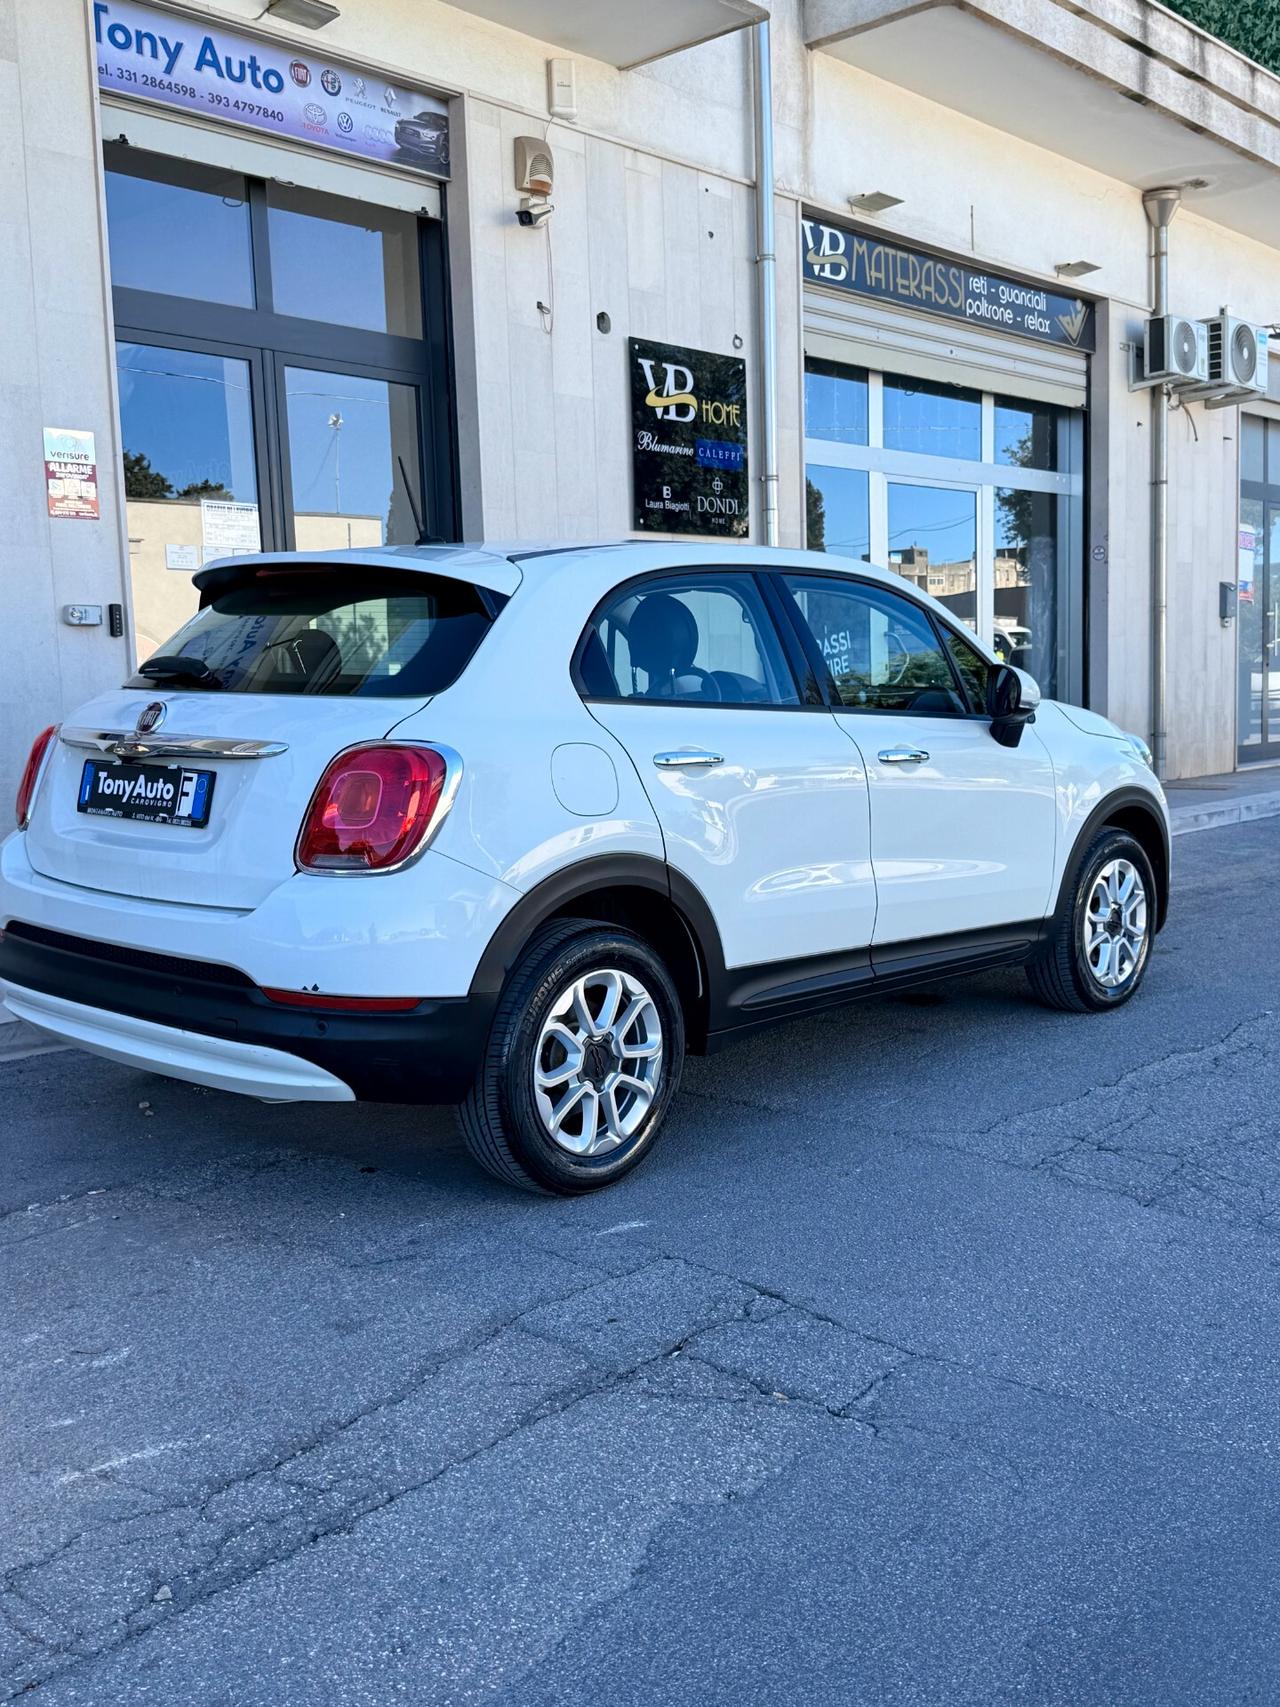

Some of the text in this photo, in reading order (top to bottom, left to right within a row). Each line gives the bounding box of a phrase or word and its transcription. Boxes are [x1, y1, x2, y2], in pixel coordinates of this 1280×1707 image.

[94, 3, 285, 94] Tony Auto
[98, 64, 113, 77] el.
[116, 67, 138, 84] 331
[141, 74, 197, 99] 2864598
[207, 92, 230, 108] 393
[232, 100, 285, 123] 4797840
[303, 123, 329, 136] TOYOTA
[851, 237, 965, 311] MATERASSI
[969, 276, 987, 295] reti
[998, 285, 1047, 312] guanciali
[966, 298, 1014, 324] poltrone
[1024, 312, 1050, 333] relax
[702, 400, 741, 427] HOME
[50, 450, 90, 461] verisure
[49, 461, 93, 475] ALLARME
[662, 486, 672, 499] B
[645, 498, 690, 513] Laura Biagiotti
[697, 496, 740, 515] DONDI
[827, 655, 851, 677] IRE
[98, 771, 175, 803] TonyAuto
